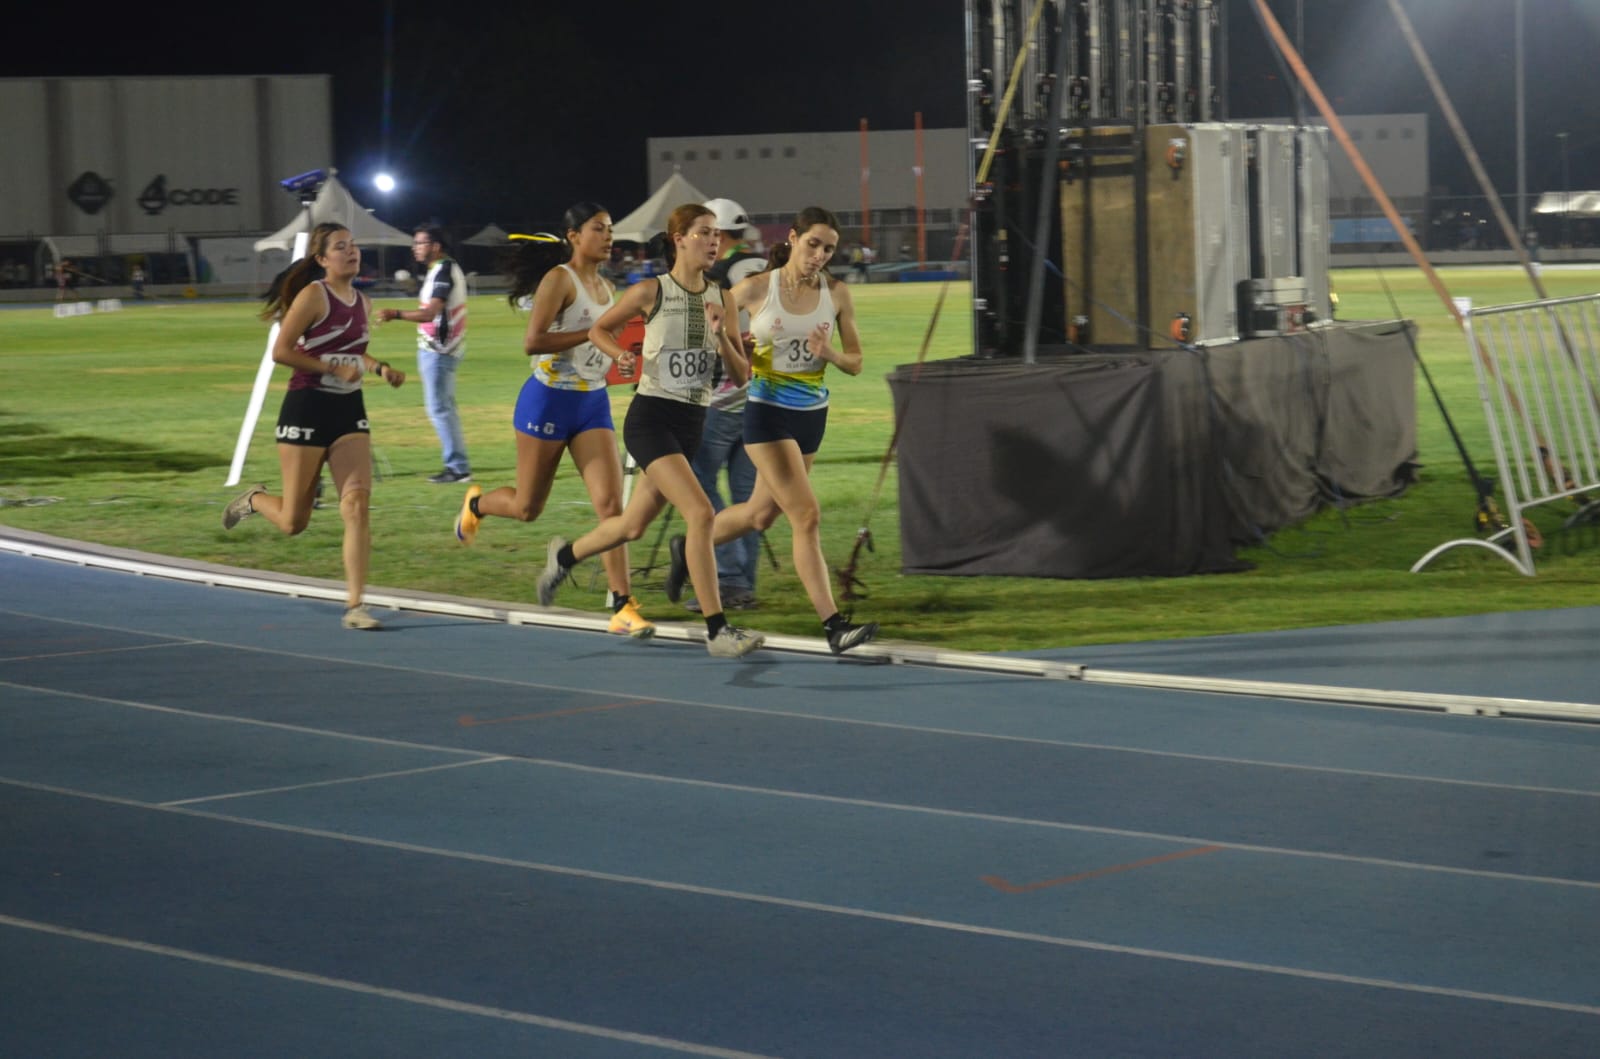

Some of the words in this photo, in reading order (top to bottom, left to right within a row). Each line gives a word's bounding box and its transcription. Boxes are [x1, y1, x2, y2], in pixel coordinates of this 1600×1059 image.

[168, 188, 240, 206] CODE
[585, 344, 604, 368] 24
[788, 338, 814, 362] 39
[669, 350, 708, 378] 688
